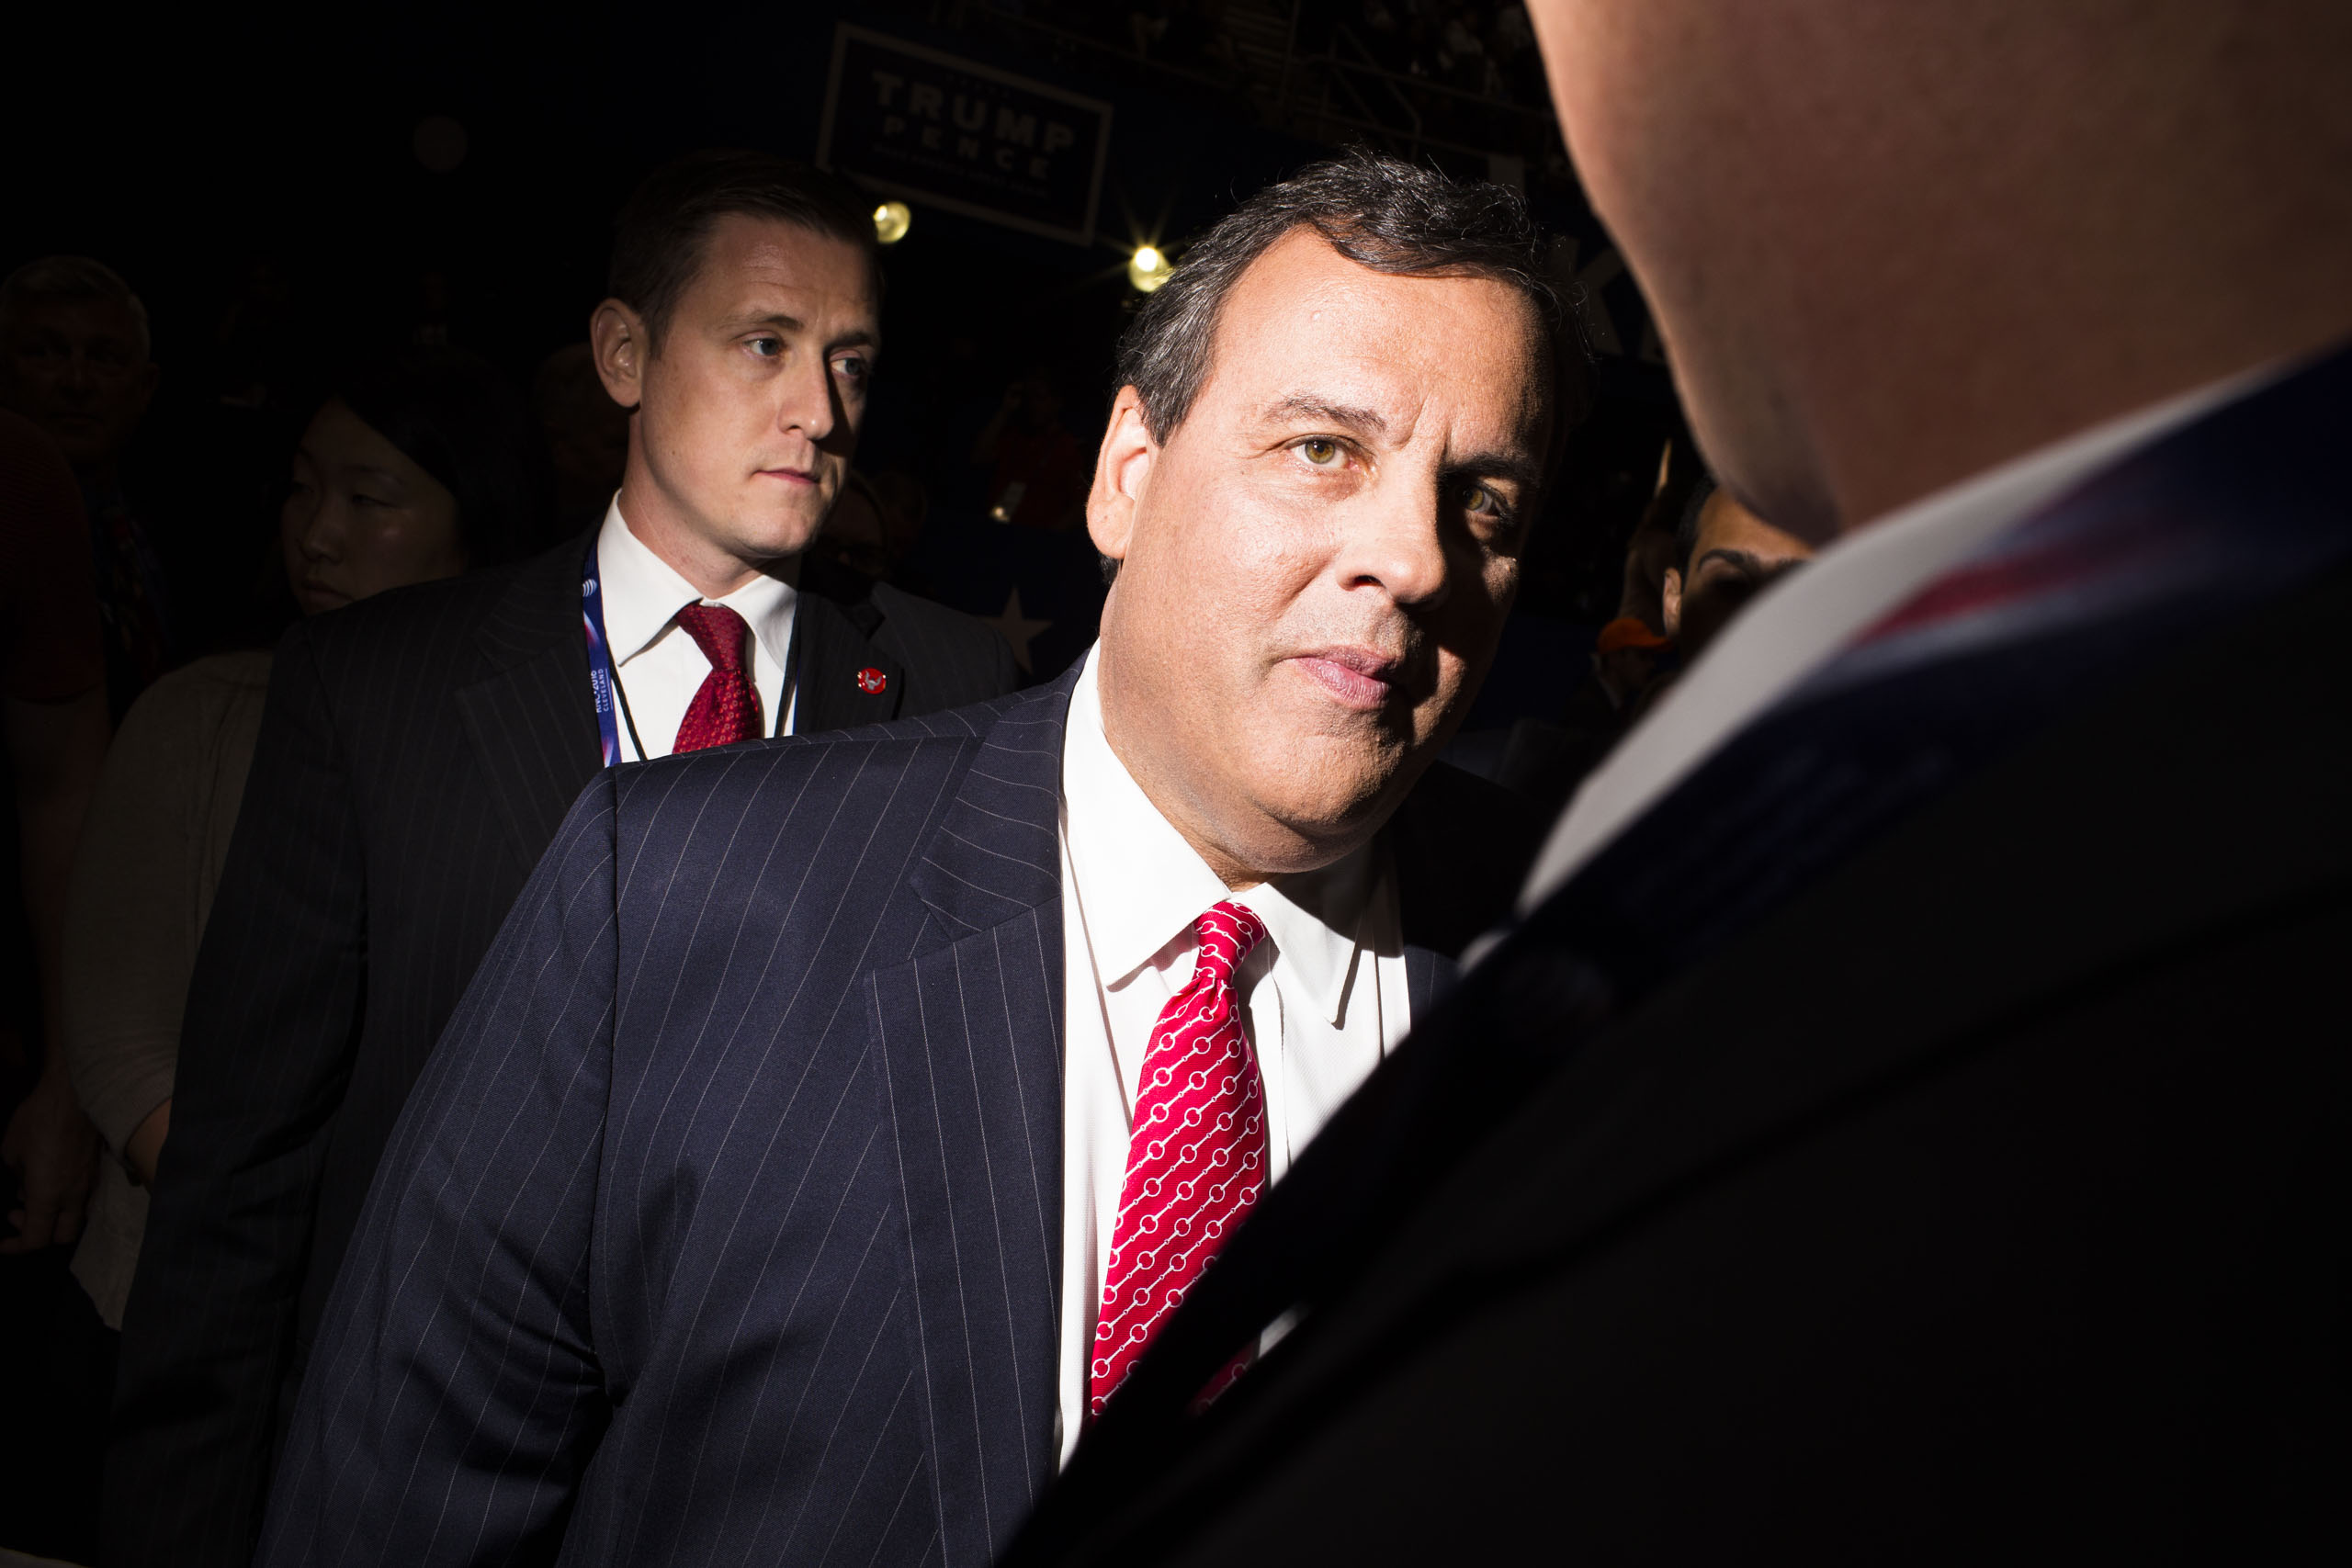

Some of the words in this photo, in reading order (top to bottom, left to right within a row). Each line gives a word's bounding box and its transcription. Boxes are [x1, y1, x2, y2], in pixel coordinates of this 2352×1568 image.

[872, 70, 1076, 153] TRUMP
[884, 115, 1050, 180] PENCE
[598, 669, 609, 712] CLEVELAND
